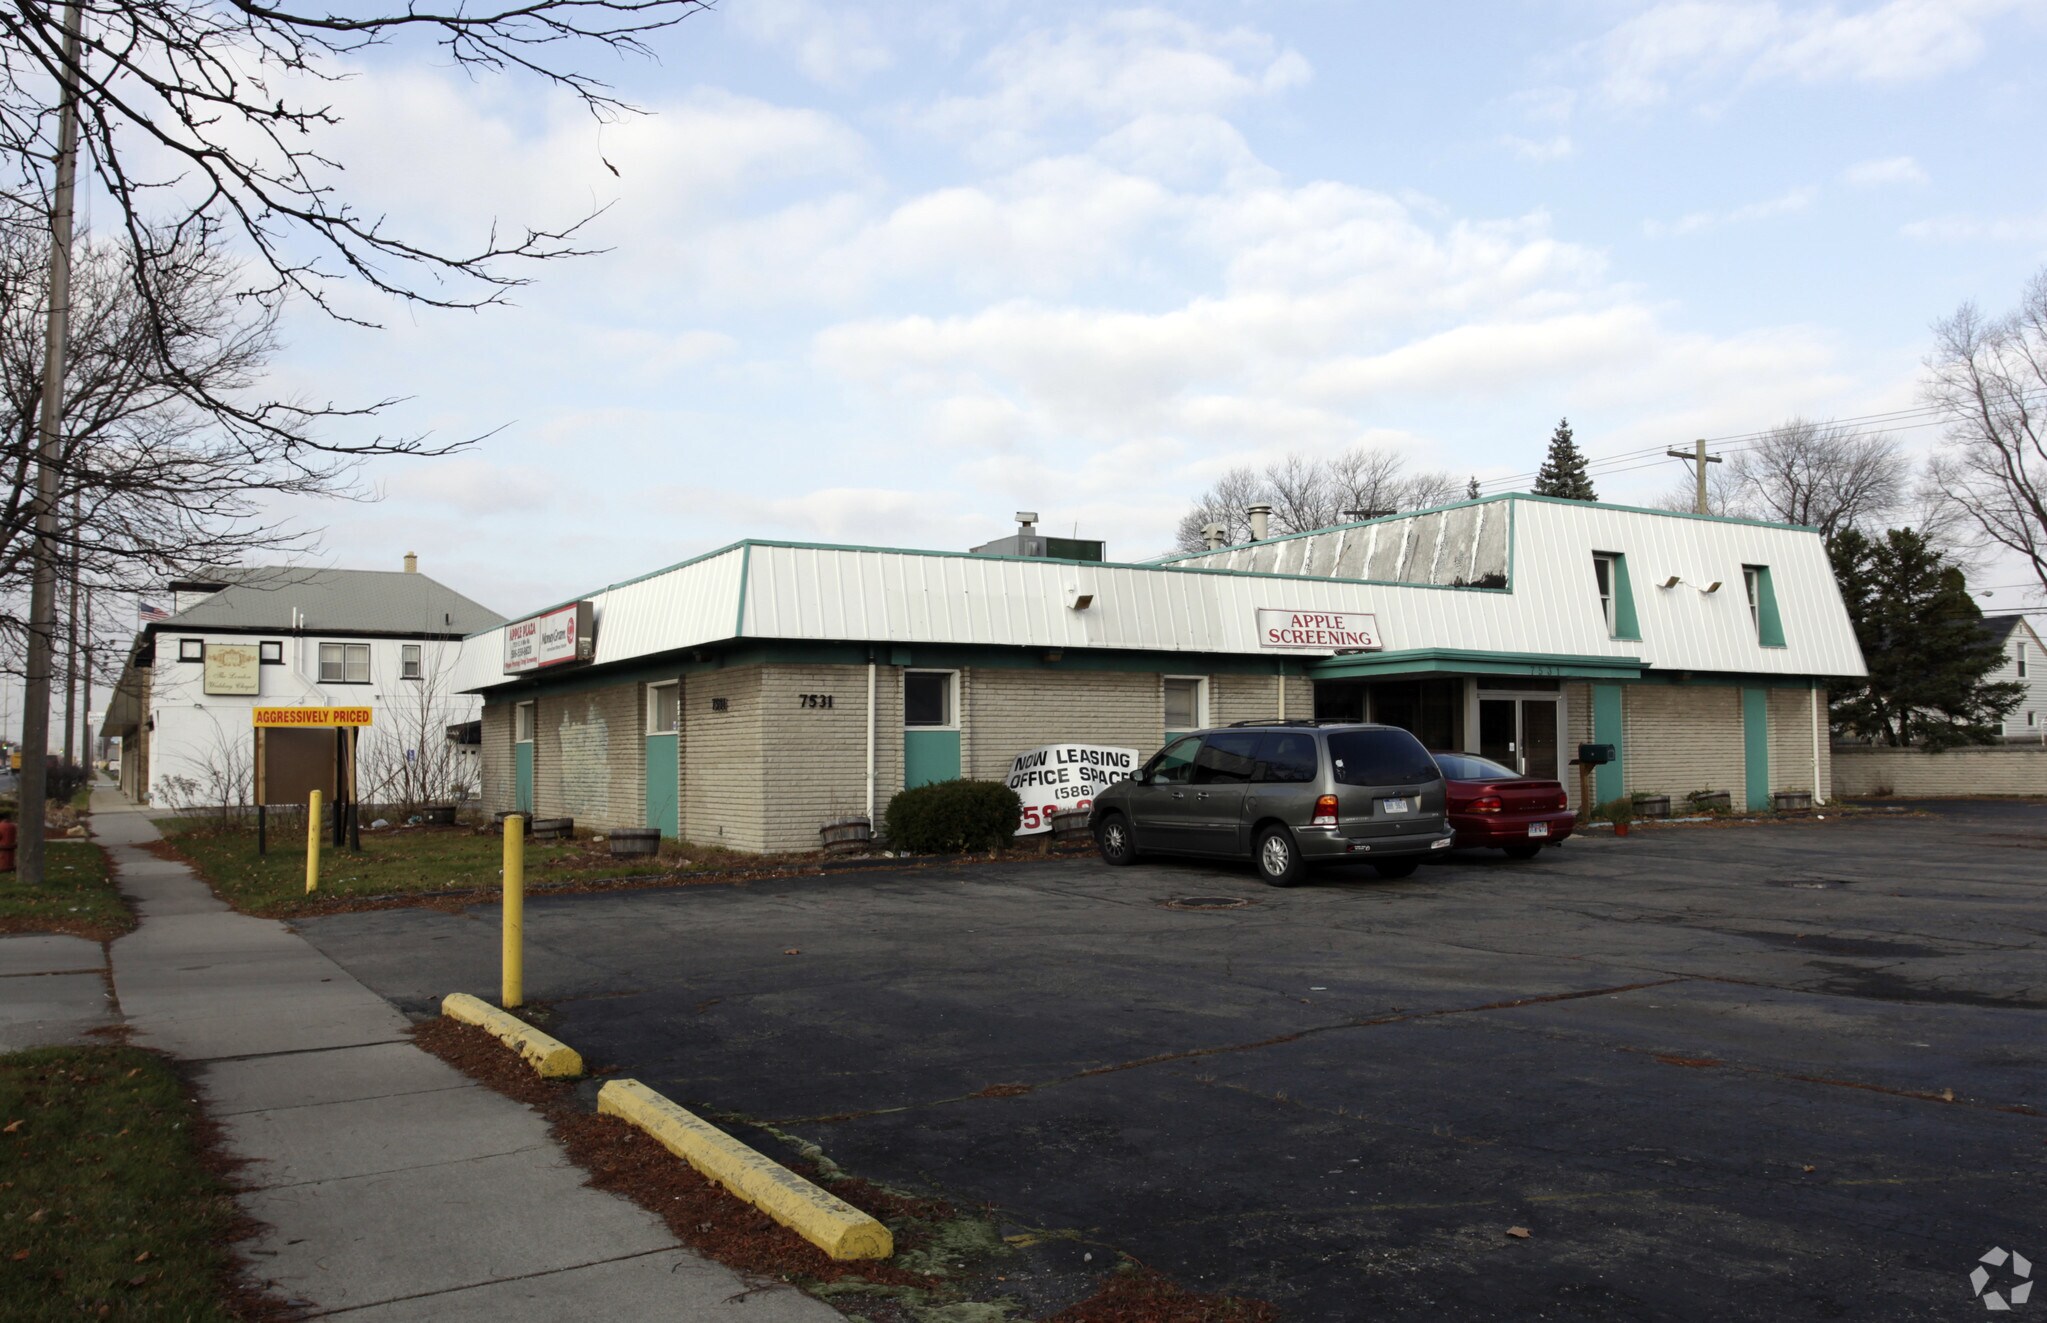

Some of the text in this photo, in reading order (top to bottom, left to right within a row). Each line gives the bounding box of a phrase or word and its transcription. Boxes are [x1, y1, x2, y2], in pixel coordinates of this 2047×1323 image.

[1291, 614, 1345, 629] APPLE
[1268, 629, 1372, 645] SCREENING
[799, 694, 833, 708] 7531
[256, 710, 369, 723] AGGRESSIVELY PRICED
[1014, 748, 1130, 772] NOW LEASING
[1010, 768, 1070, 789] OFFICE
[1055, 785, 1094, 800] (586)
